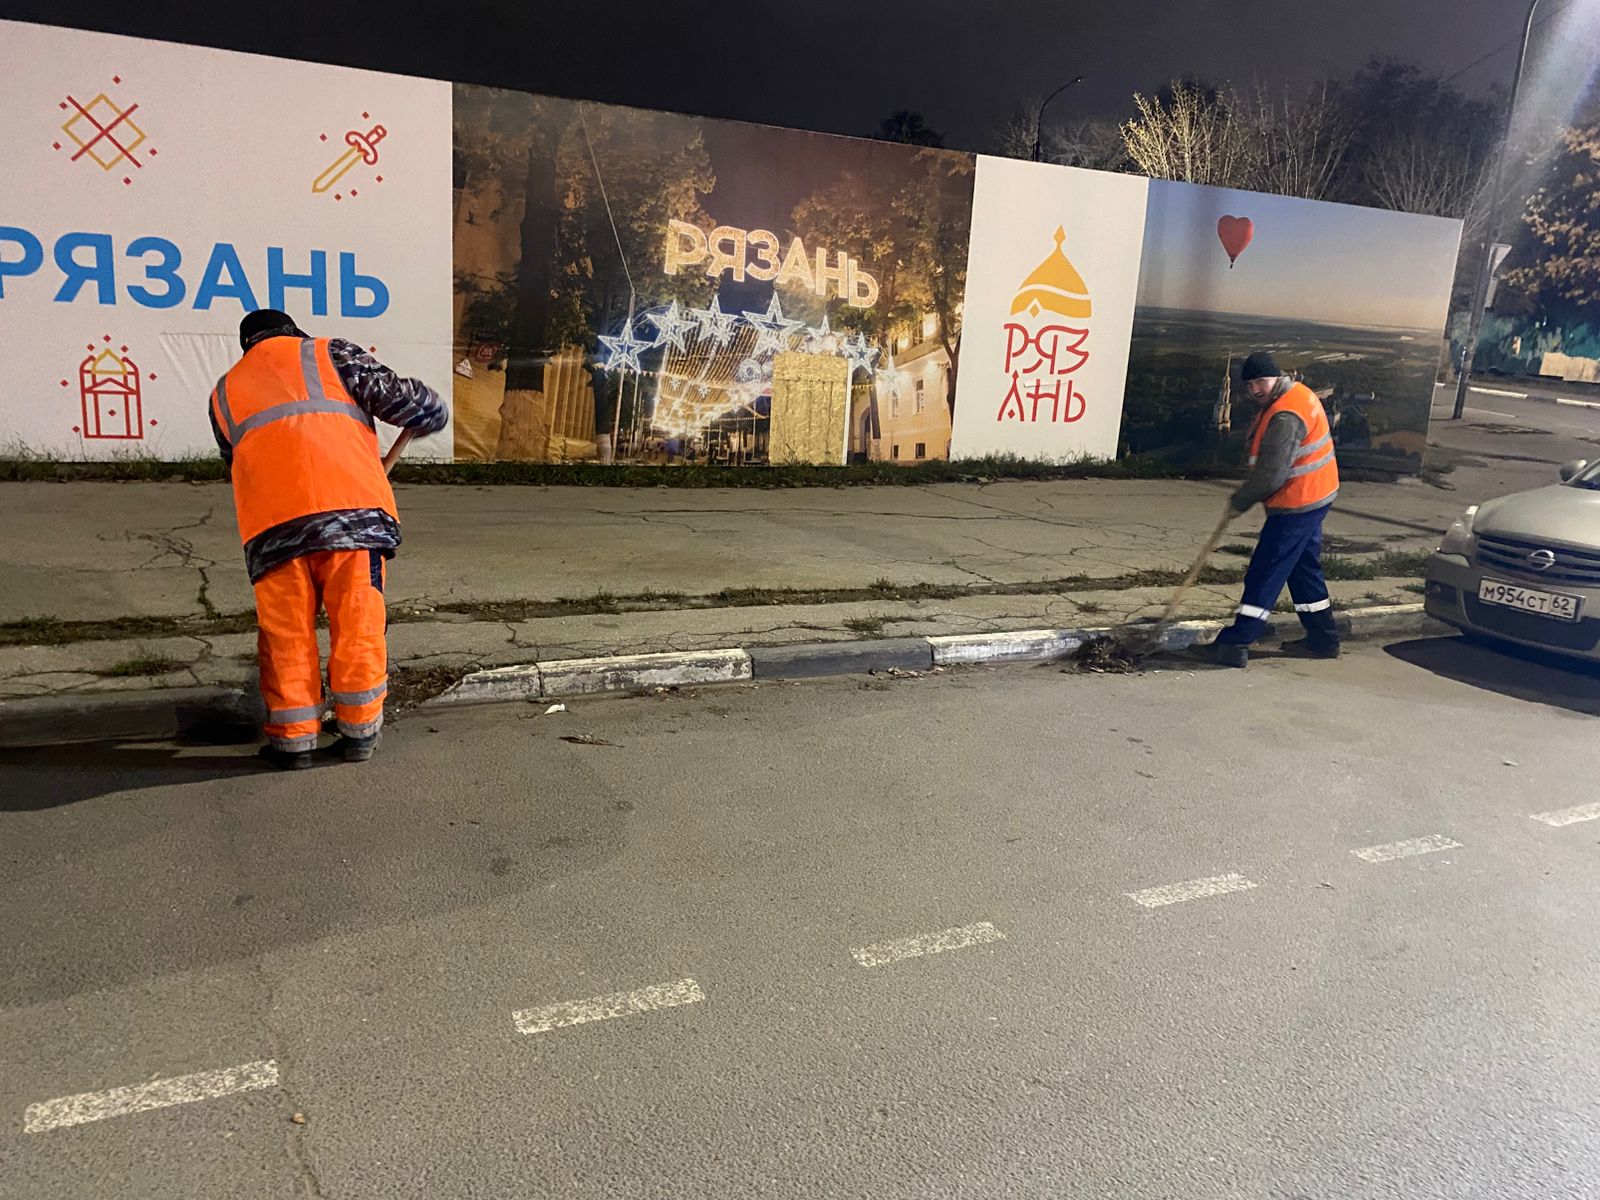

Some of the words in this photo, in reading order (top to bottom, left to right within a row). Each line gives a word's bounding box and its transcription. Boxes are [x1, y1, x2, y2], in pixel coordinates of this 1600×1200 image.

[0, 226, 390, 319] РЯЗАНЬ
[664, 219, 879, 308] РЯЗАНЬ
[1004, 323, 1089, 375] РЯЗ
[997, 370, 1087, 423] АНЬ
